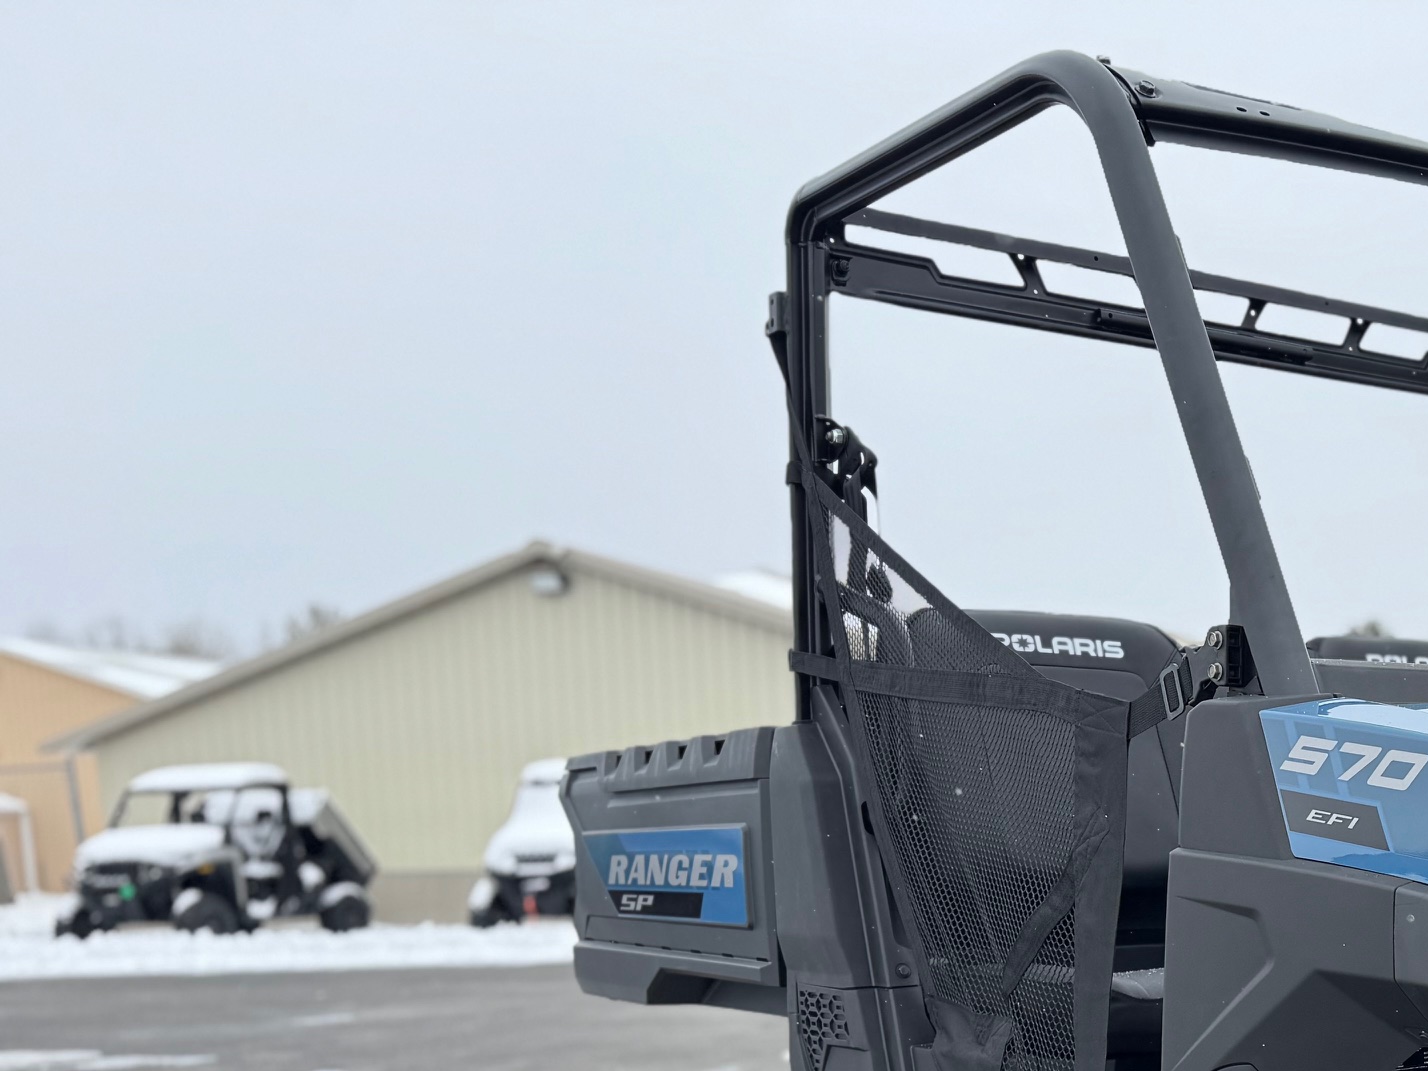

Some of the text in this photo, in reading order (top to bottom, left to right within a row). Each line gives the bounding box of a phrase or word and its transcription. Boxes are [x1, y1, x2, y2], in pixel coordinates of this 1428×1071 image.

[1306, 809, 1359, 829] EFI
[607, 853, 739, 889] RANGER
[619, 893, 654, 911] SP
